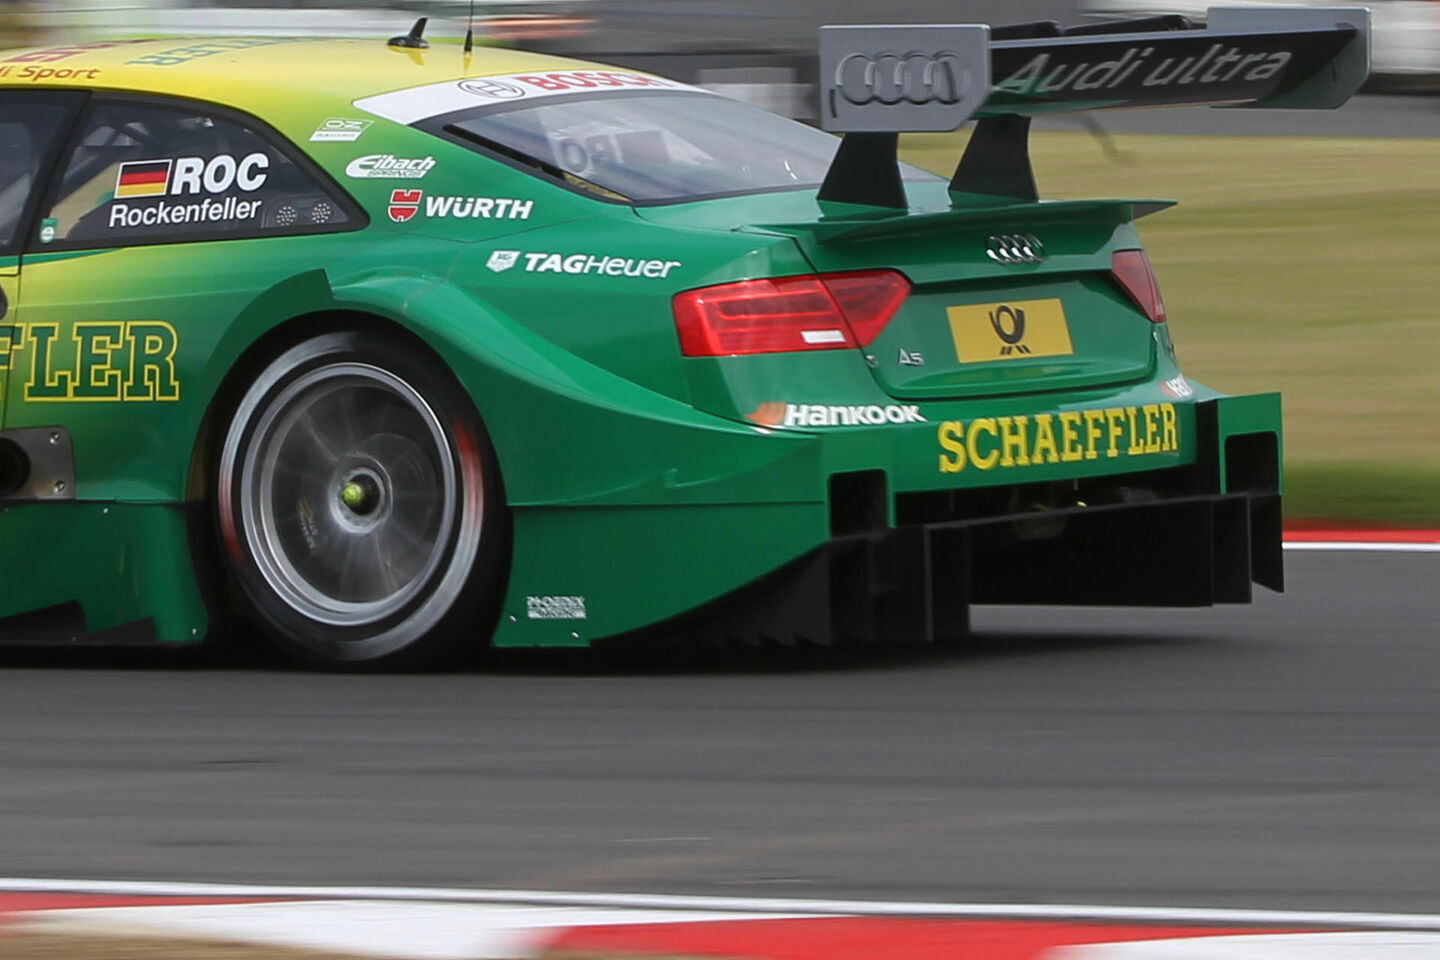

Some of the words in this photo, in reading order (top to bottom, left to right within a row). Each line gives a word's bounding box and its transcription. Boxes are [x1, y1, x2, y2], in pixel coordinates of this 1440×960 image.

[17, 65, 101, 82] Sport
[997, 43, 1155, 93] Audi
[1142, 43, 1292, 86] ultra
[171, 153, 269, 195] ROC
[345, 154, 437, 178] Eibach
[109, 198, 261, 228] Rockenfeller
[937, 402, 1180, 474] SCHAEFFLER
